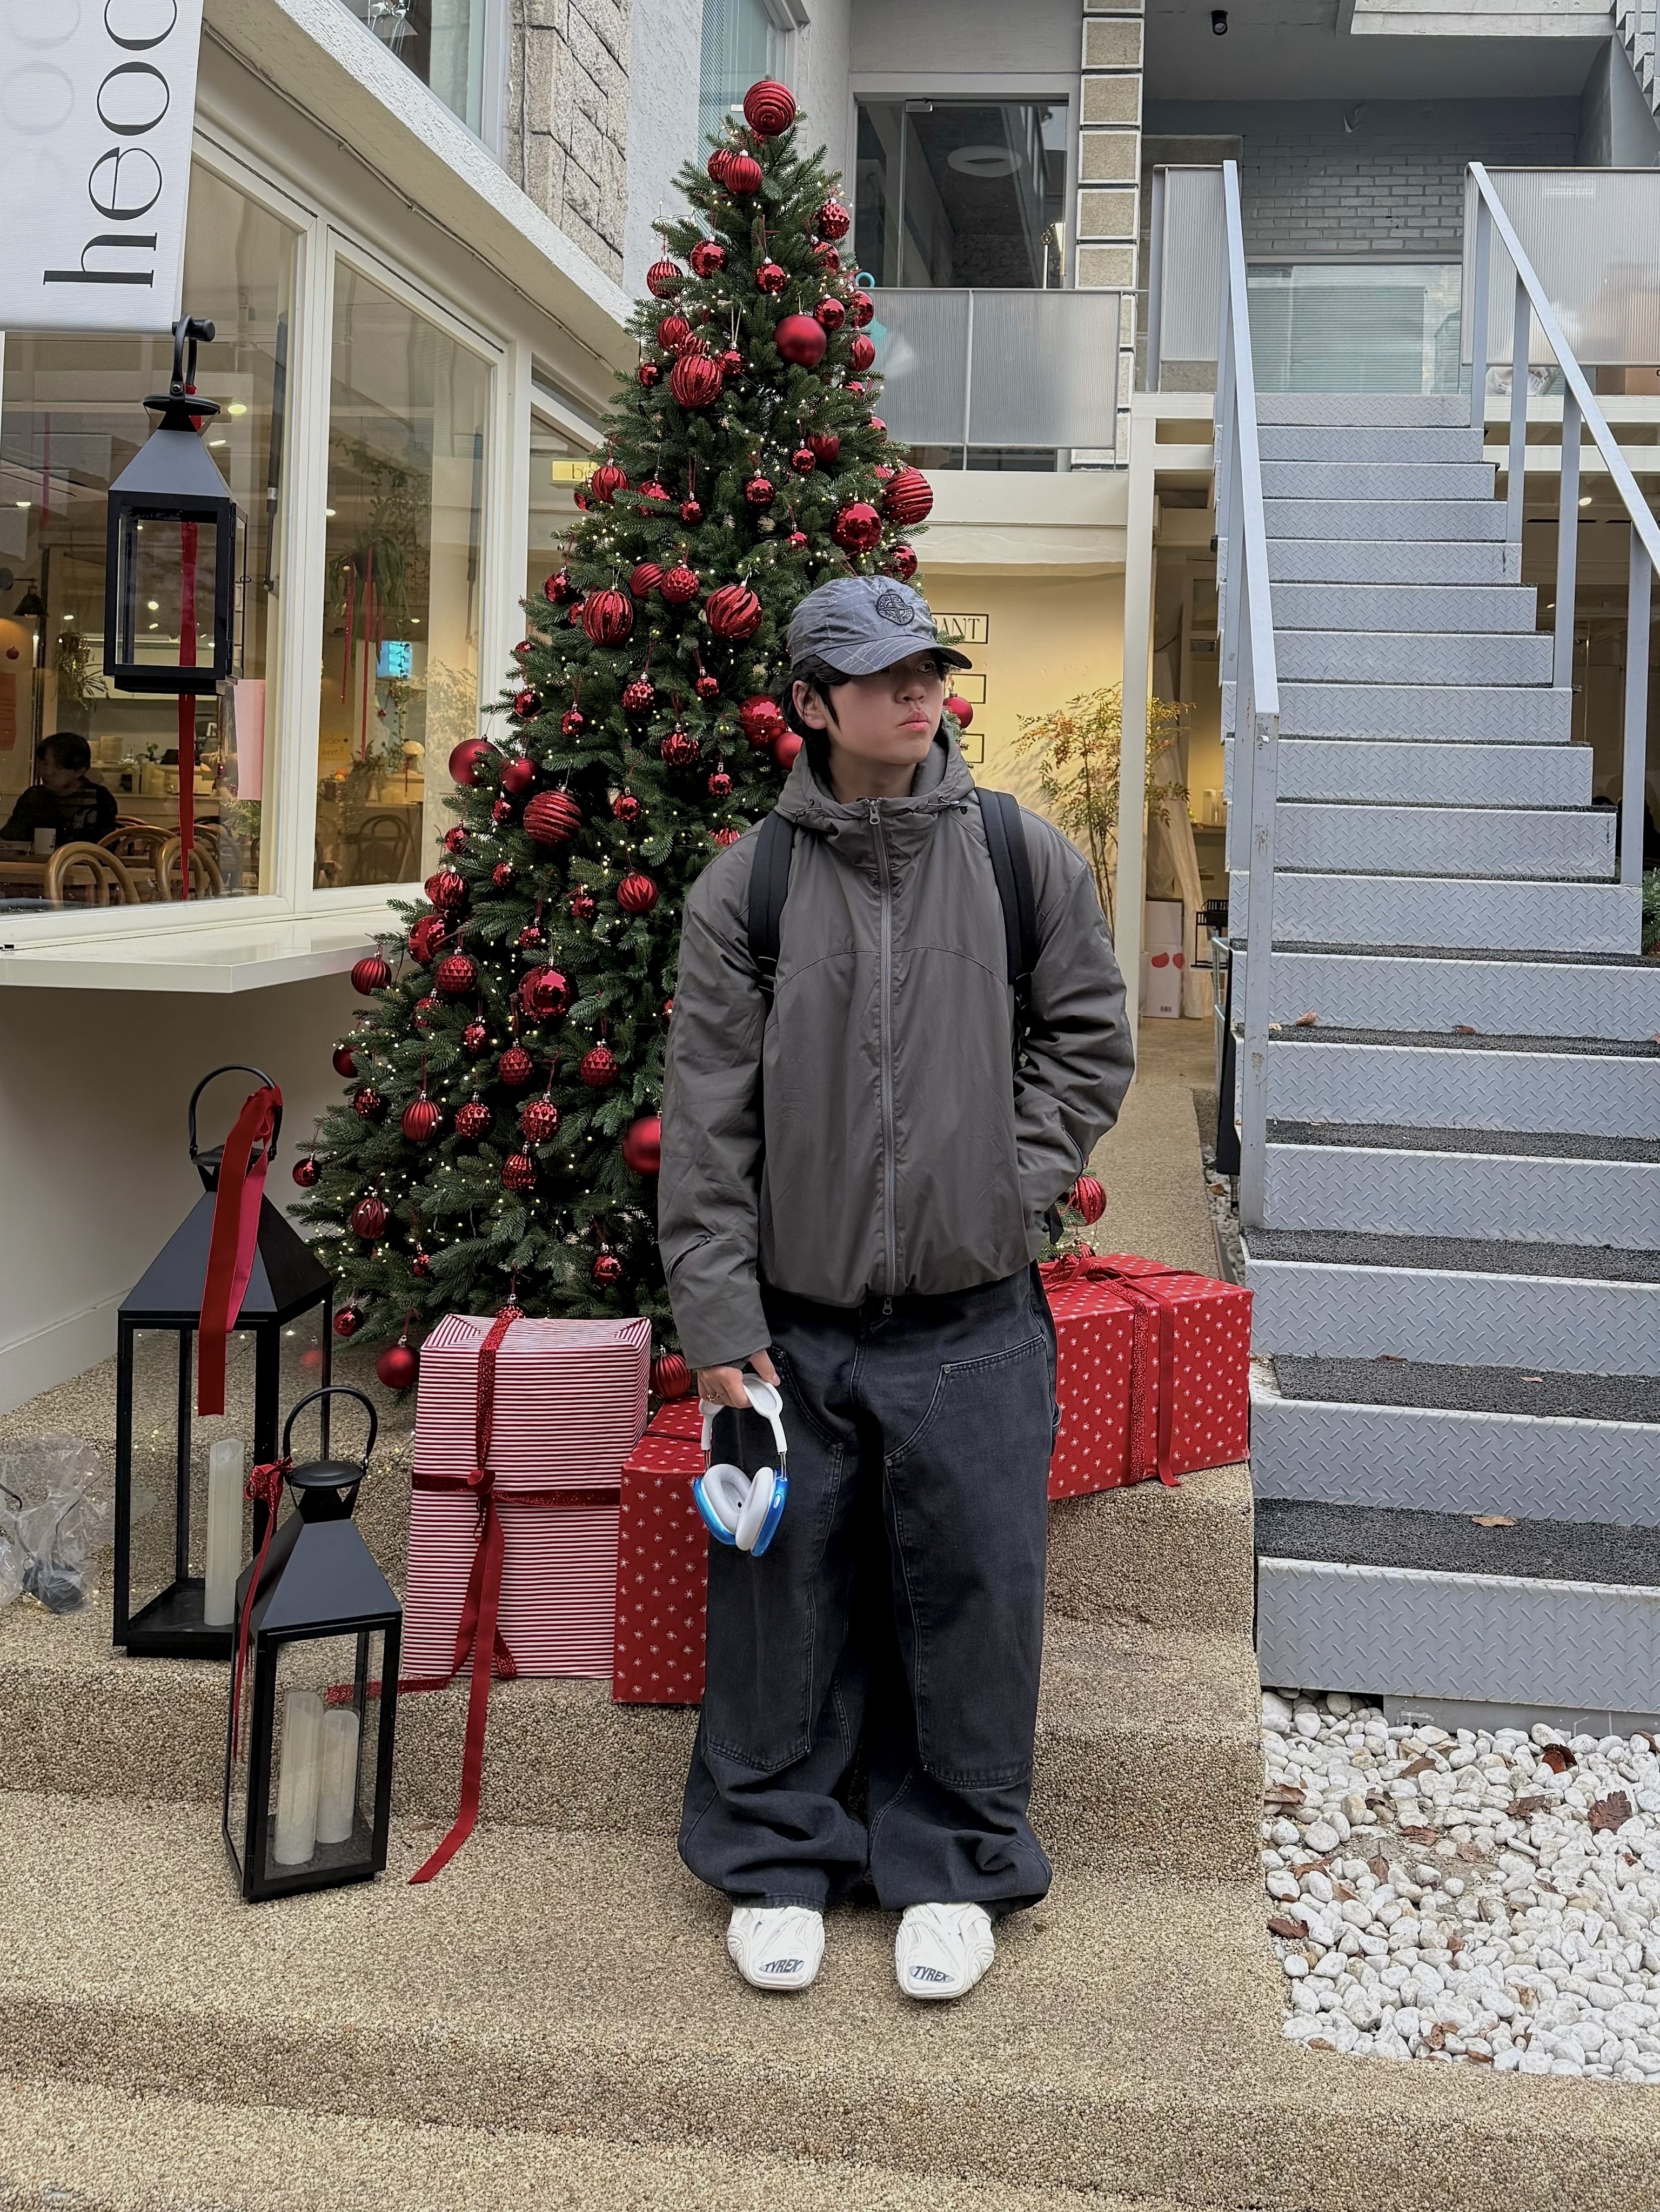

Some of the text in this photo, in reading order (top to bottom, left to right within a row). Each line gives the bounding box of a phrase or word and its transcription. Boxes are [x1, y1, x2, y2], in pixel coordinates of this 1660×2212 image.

[933, 618, 980, 639] ANT
[765, 1959, 804, 1973] TYREX
[913, 1966, 949, 1982] TYREX
